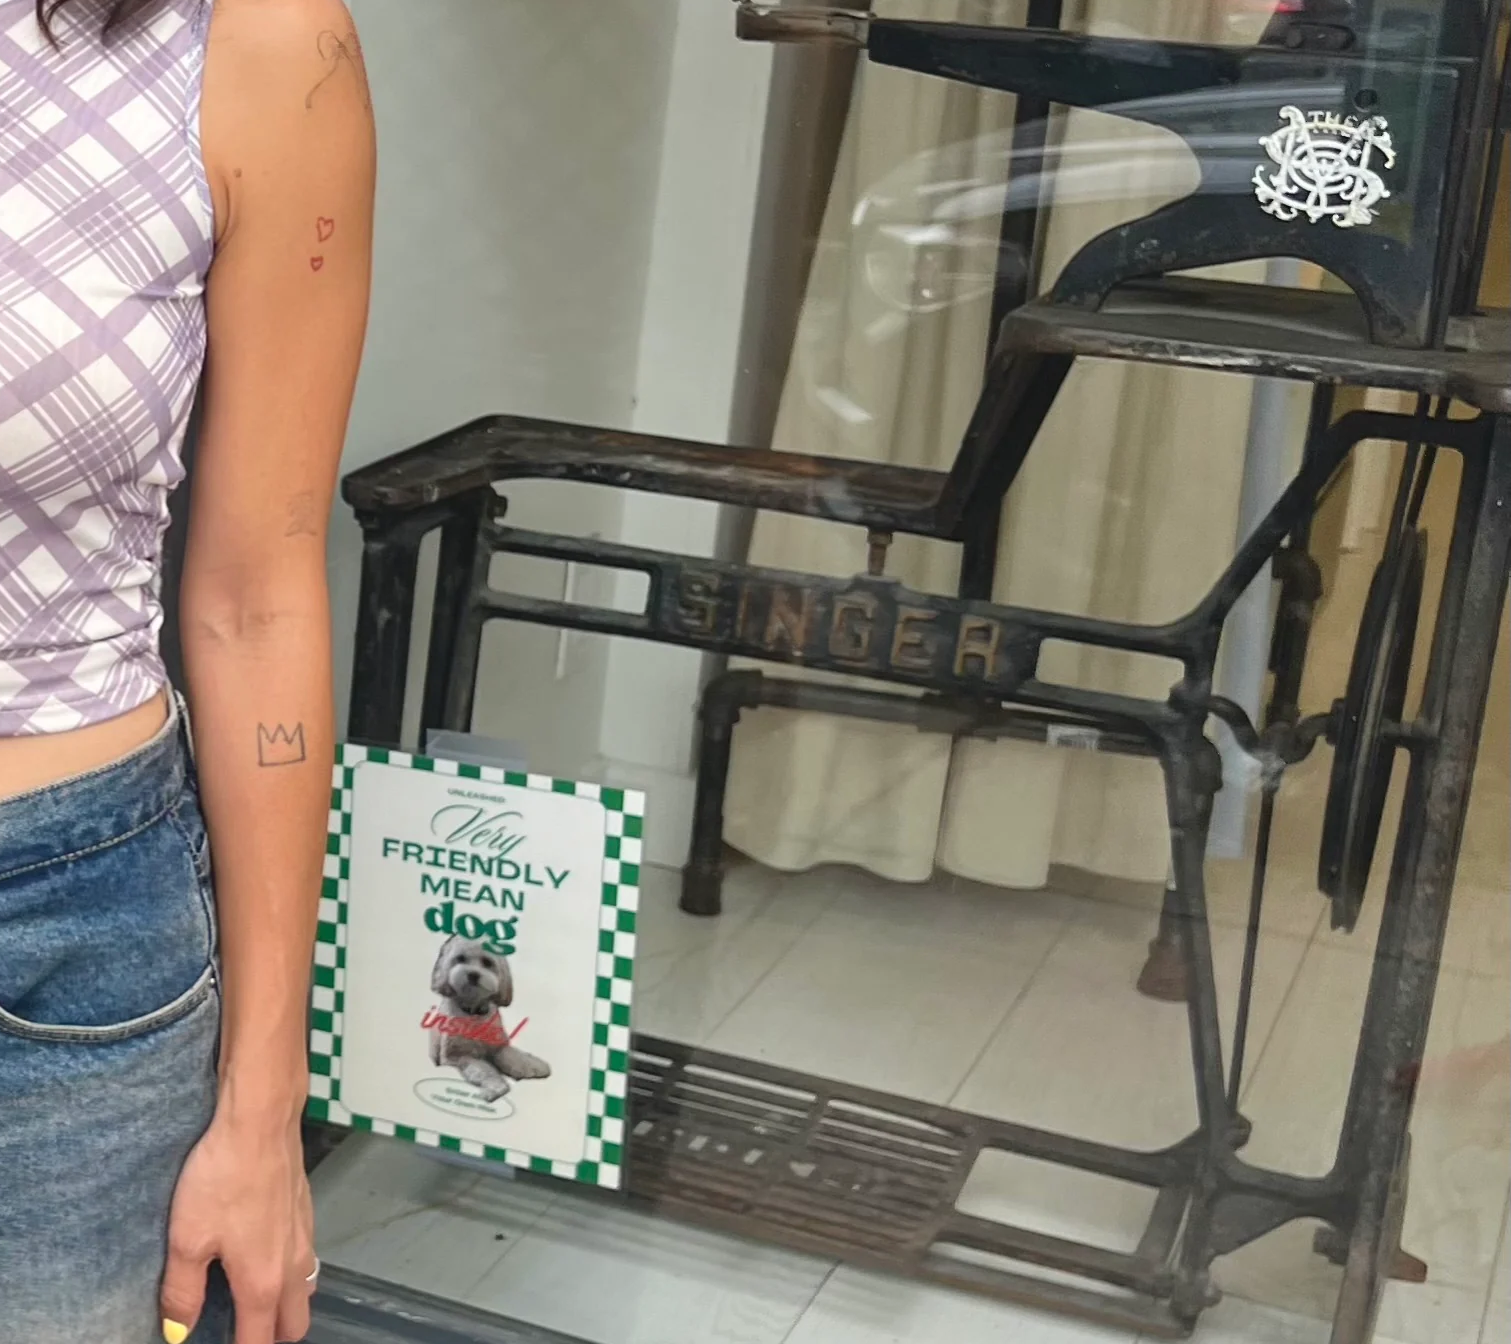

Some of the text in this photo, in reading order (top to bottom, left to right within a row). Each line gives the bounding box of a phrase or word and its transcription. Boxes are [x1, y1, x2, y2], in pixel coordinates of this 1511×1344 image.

[678, 568, 1002, 681] SINGER
[430, 803, 528, 863] Very
[382, 837, 571, 890] FRIENDLY
[420, 872, 525, 913] MEAN
[423, 901, 519, 956] dog
